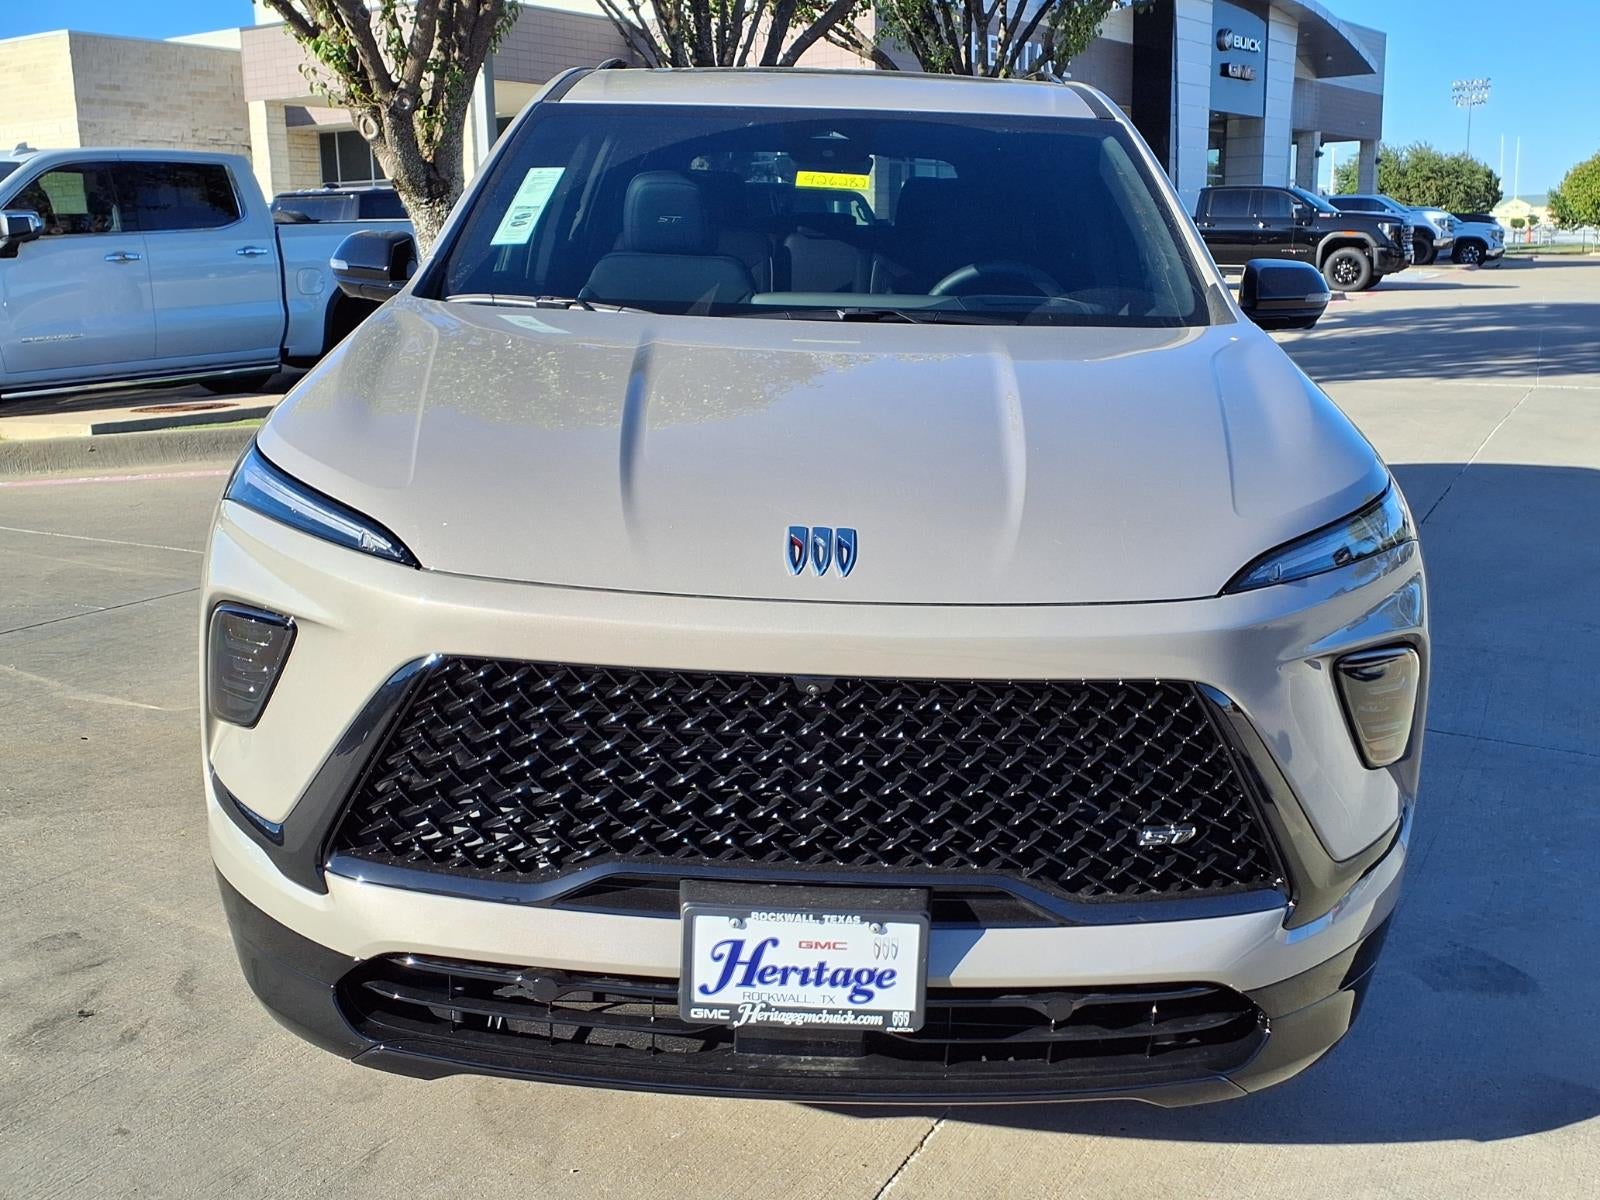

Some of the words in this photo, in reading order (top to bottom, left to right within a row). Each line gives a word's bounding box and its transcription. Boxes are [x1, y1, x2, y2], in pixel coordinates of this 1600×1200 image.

[1233, 35, 1261, 52] BUICK
[822, 915, 861, 925] TEXAS
[798, 940, 848, 951] GMC
[698, 937, 897, 1005] Heritage
[821, 995, 836, 1004] TX
[690, 1008, 730, 1020] GMC
[733, 1003, 883, 1027] Heritagegmcbuick.com
